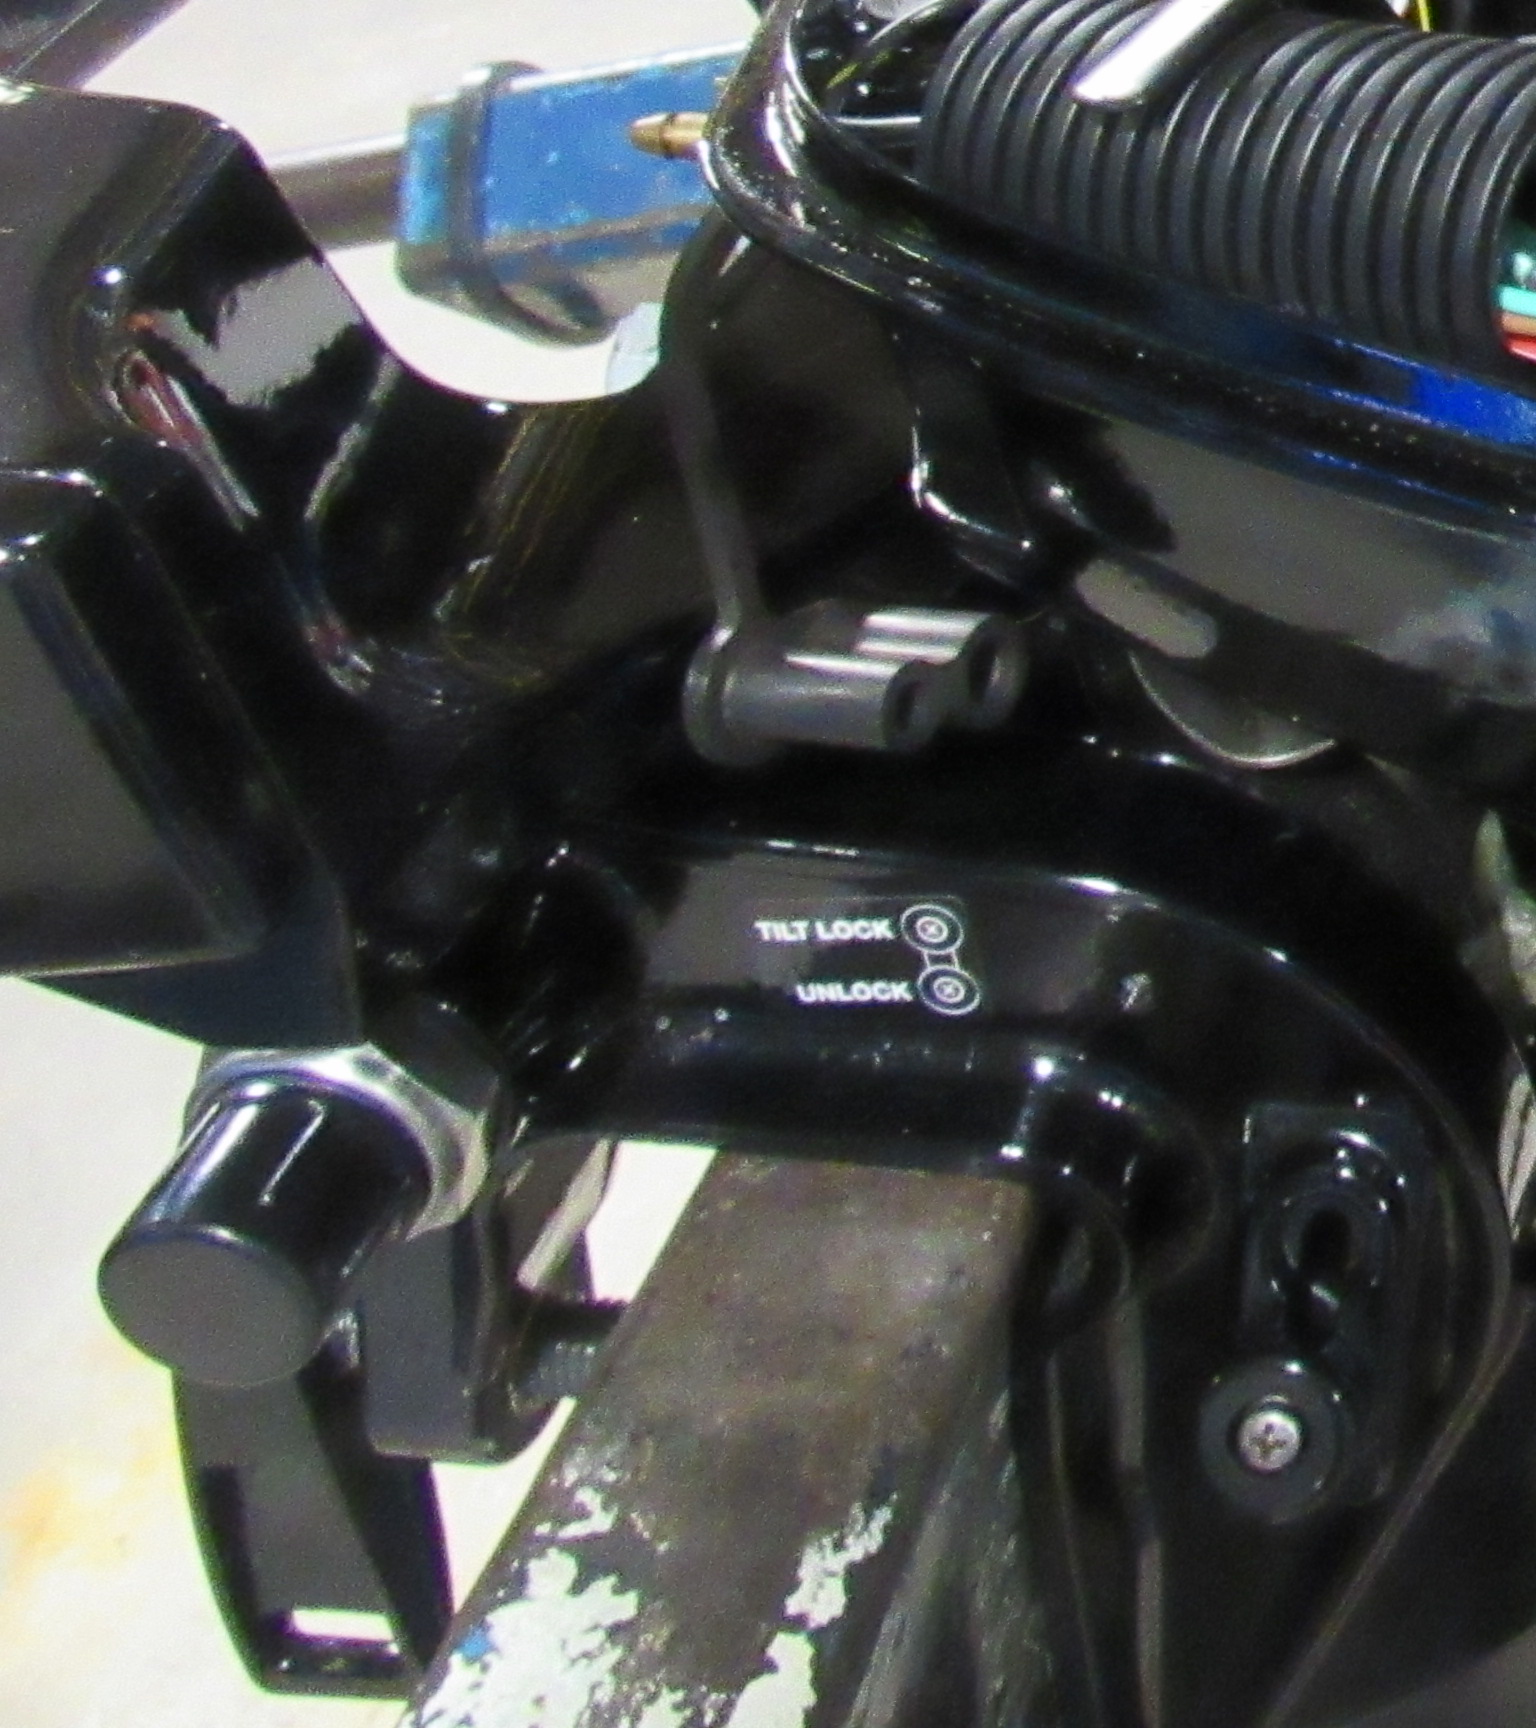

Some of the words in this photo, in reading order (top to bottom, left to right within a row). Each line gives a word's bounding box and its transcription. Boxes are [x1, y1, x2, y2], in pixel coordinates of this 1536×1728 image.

[753, 919, 809, 941] TILT
[814, 918, 894, 941] LOCK
[796, 981, 913, 1003] UNLOCK
